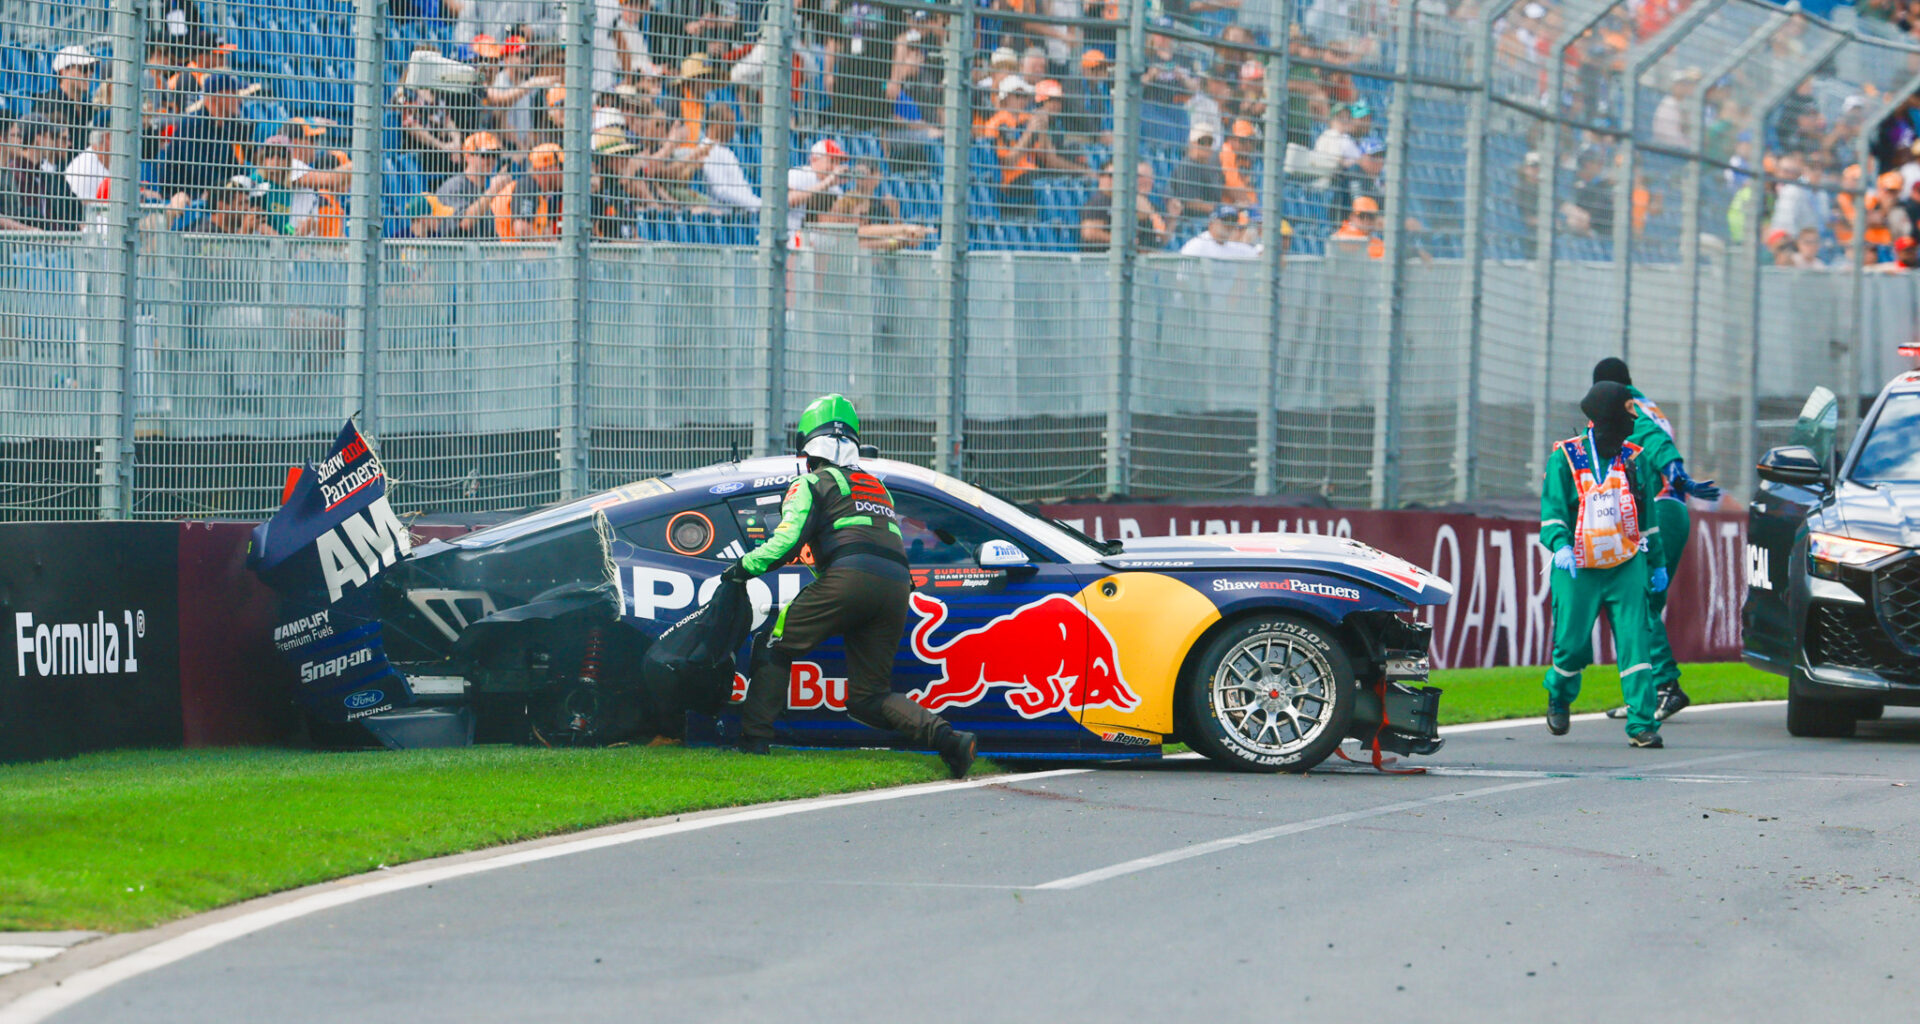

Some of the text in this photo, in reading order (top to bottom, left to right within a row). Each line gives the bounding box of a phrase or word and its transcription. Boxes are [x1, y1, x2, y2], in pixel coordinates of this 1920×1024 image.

[320, 457, 380, 509] Partners
[316, 495, 411, 604] AM
[962, 579, 989, 588] Repco
[281, 609, 329, 639] AMPLIFY
[311, 624, 334, 641] Fuels
[659, 625, 675, 640] new
[1257, 621, 1331, 652] DUNLOP
[15, 610, 119, 676] Formula
[300, 647, 373, 684] Snap-on
[346, 703, 393, 721] RACING
[1113, 731, 1151, 746] Repco
